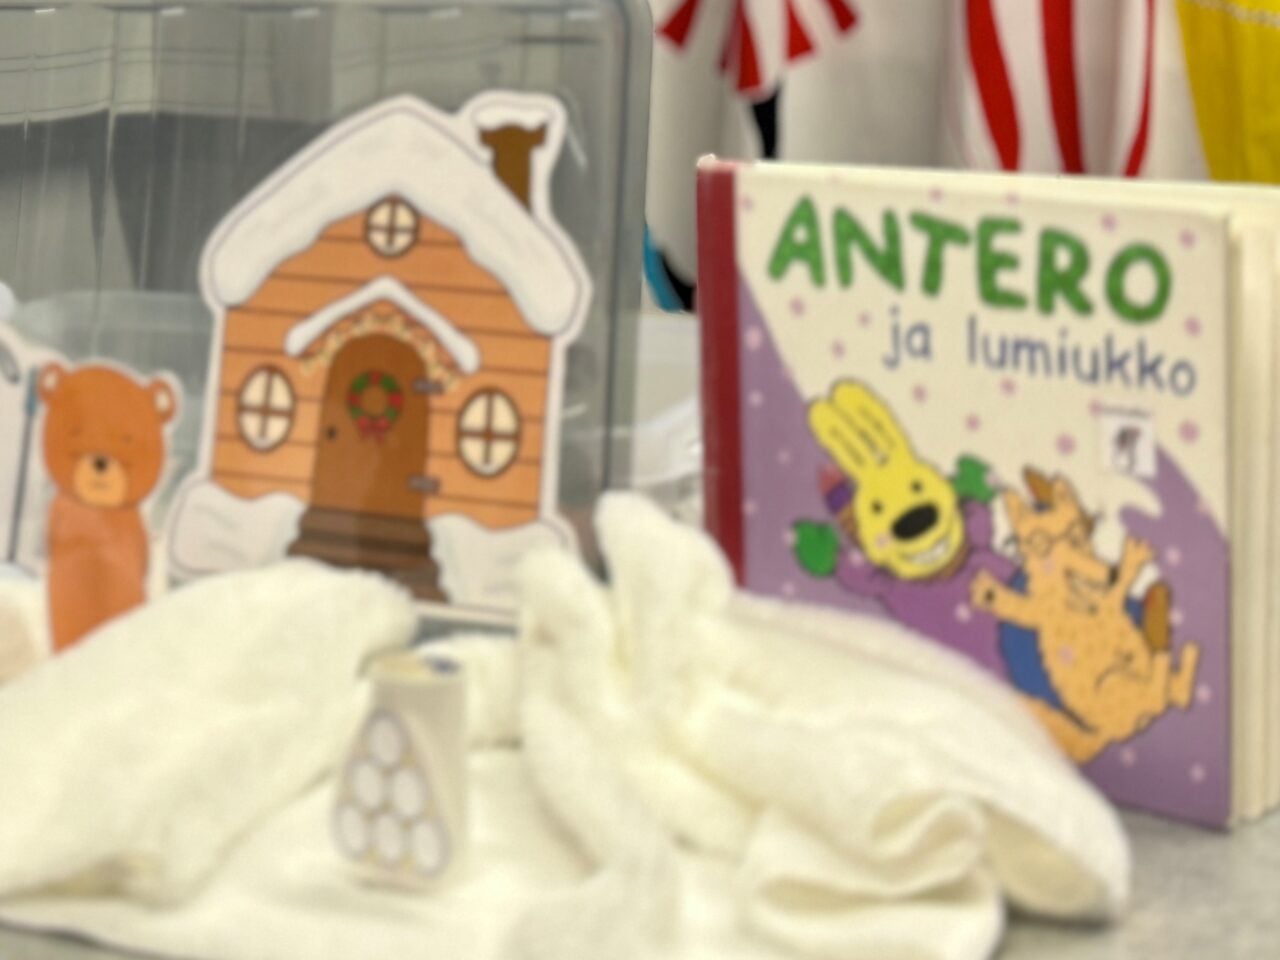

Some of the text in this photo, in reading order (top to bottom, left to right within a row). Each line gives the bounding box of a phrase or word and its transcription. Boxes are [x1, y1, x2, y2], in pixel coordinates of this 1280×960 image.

[767, 195, 1172, 324] ANTERO
[882, 305, 1197, 397] ja lumiukko
